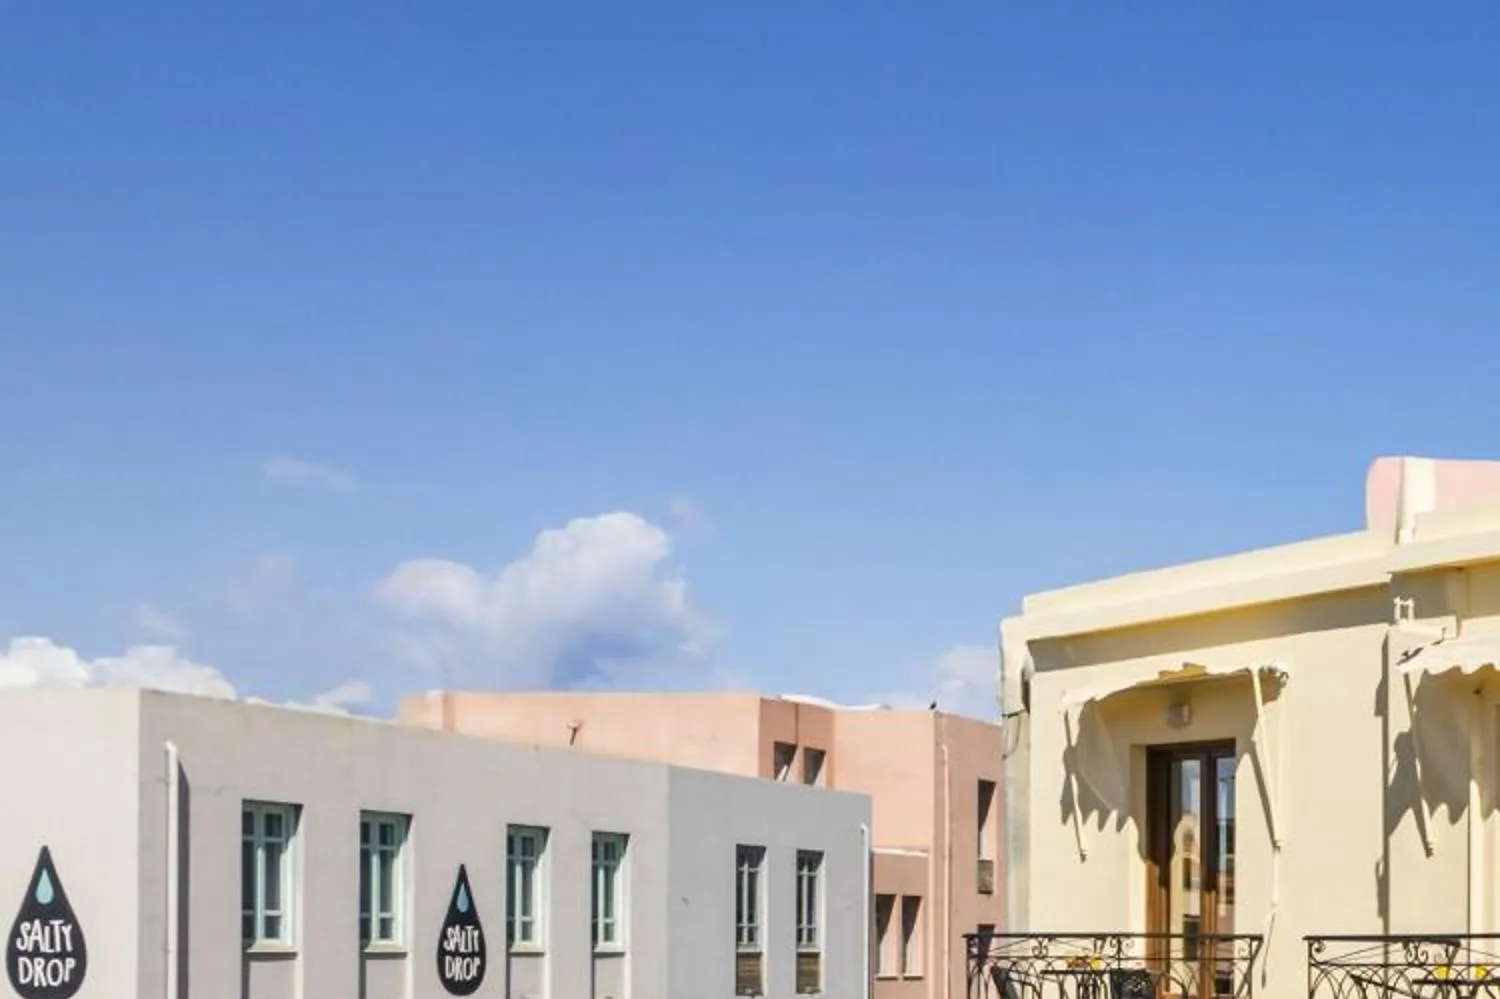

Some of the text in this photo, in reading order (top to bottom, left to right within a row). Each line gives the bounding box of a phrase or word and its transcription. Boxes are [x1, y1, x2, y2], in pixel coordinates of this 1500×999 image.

[15, 918, 73, 952] SALTY
[443, 924, 479, 952] SALTY
[18, 956, 76, 987] DROP
[444, 956, 480, 982] DROP
